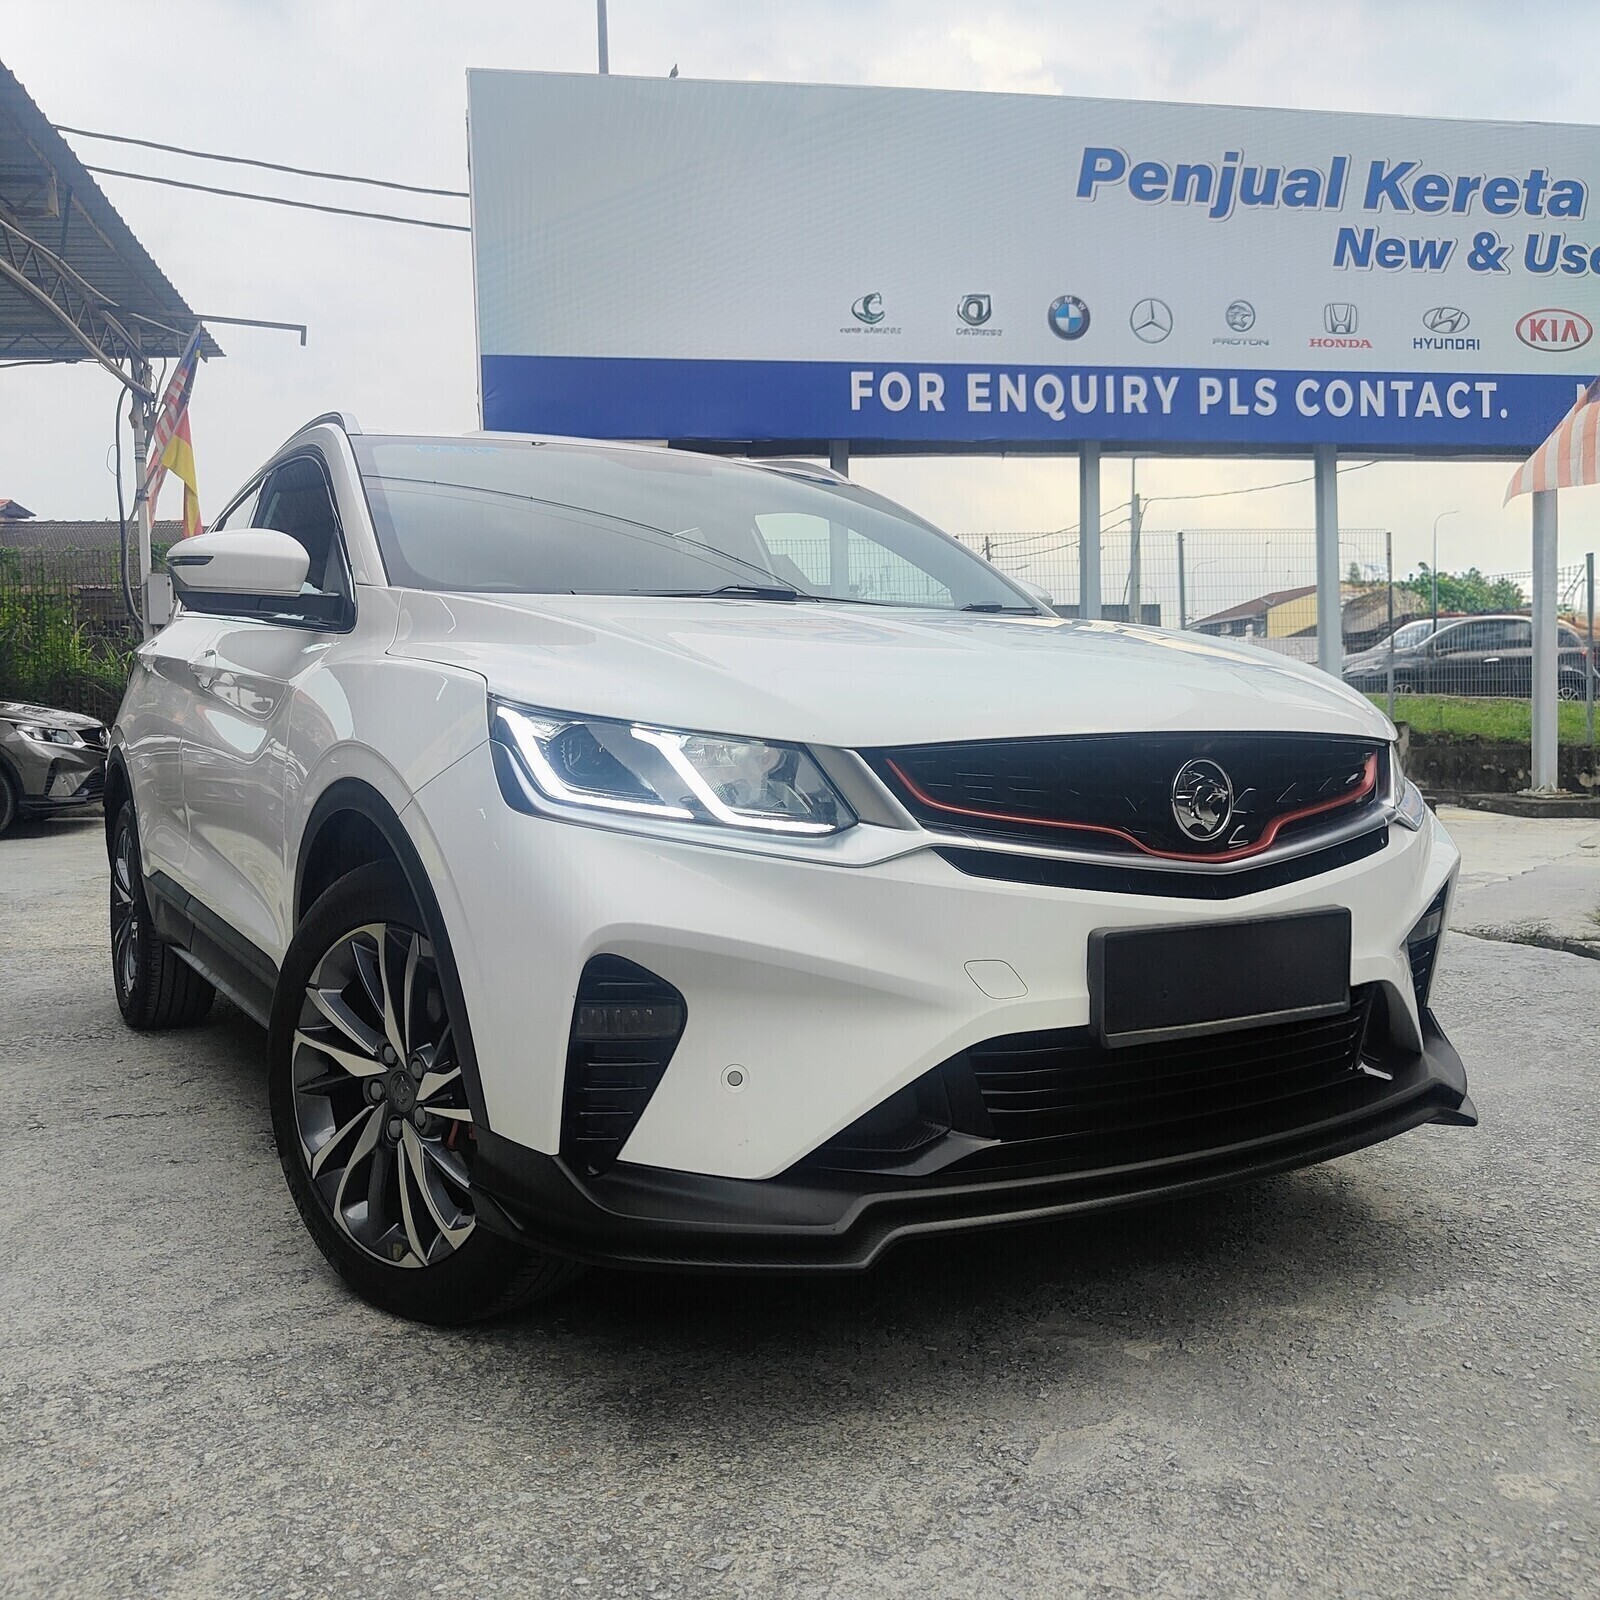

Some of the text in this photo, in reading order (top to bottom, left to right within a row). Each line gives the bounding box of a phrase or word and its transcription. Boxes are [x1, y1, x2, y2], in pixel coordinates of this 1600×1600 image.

[1076, 147, 1585, 219] Penjual Kereta
[1333, 227, 1454, 270] New
[1467, 231, 1510, 272] &
[1212, 338, 1270, 346] PROTON
[1529, 318, 1577, 343] KIA
[1308, 338, 1373, 349] HONDA
[1412, 337, 1480, 351] HYUNDAI
[850, 371, 1509, 421] FOR ENQUIRY PLS CONTACT.
